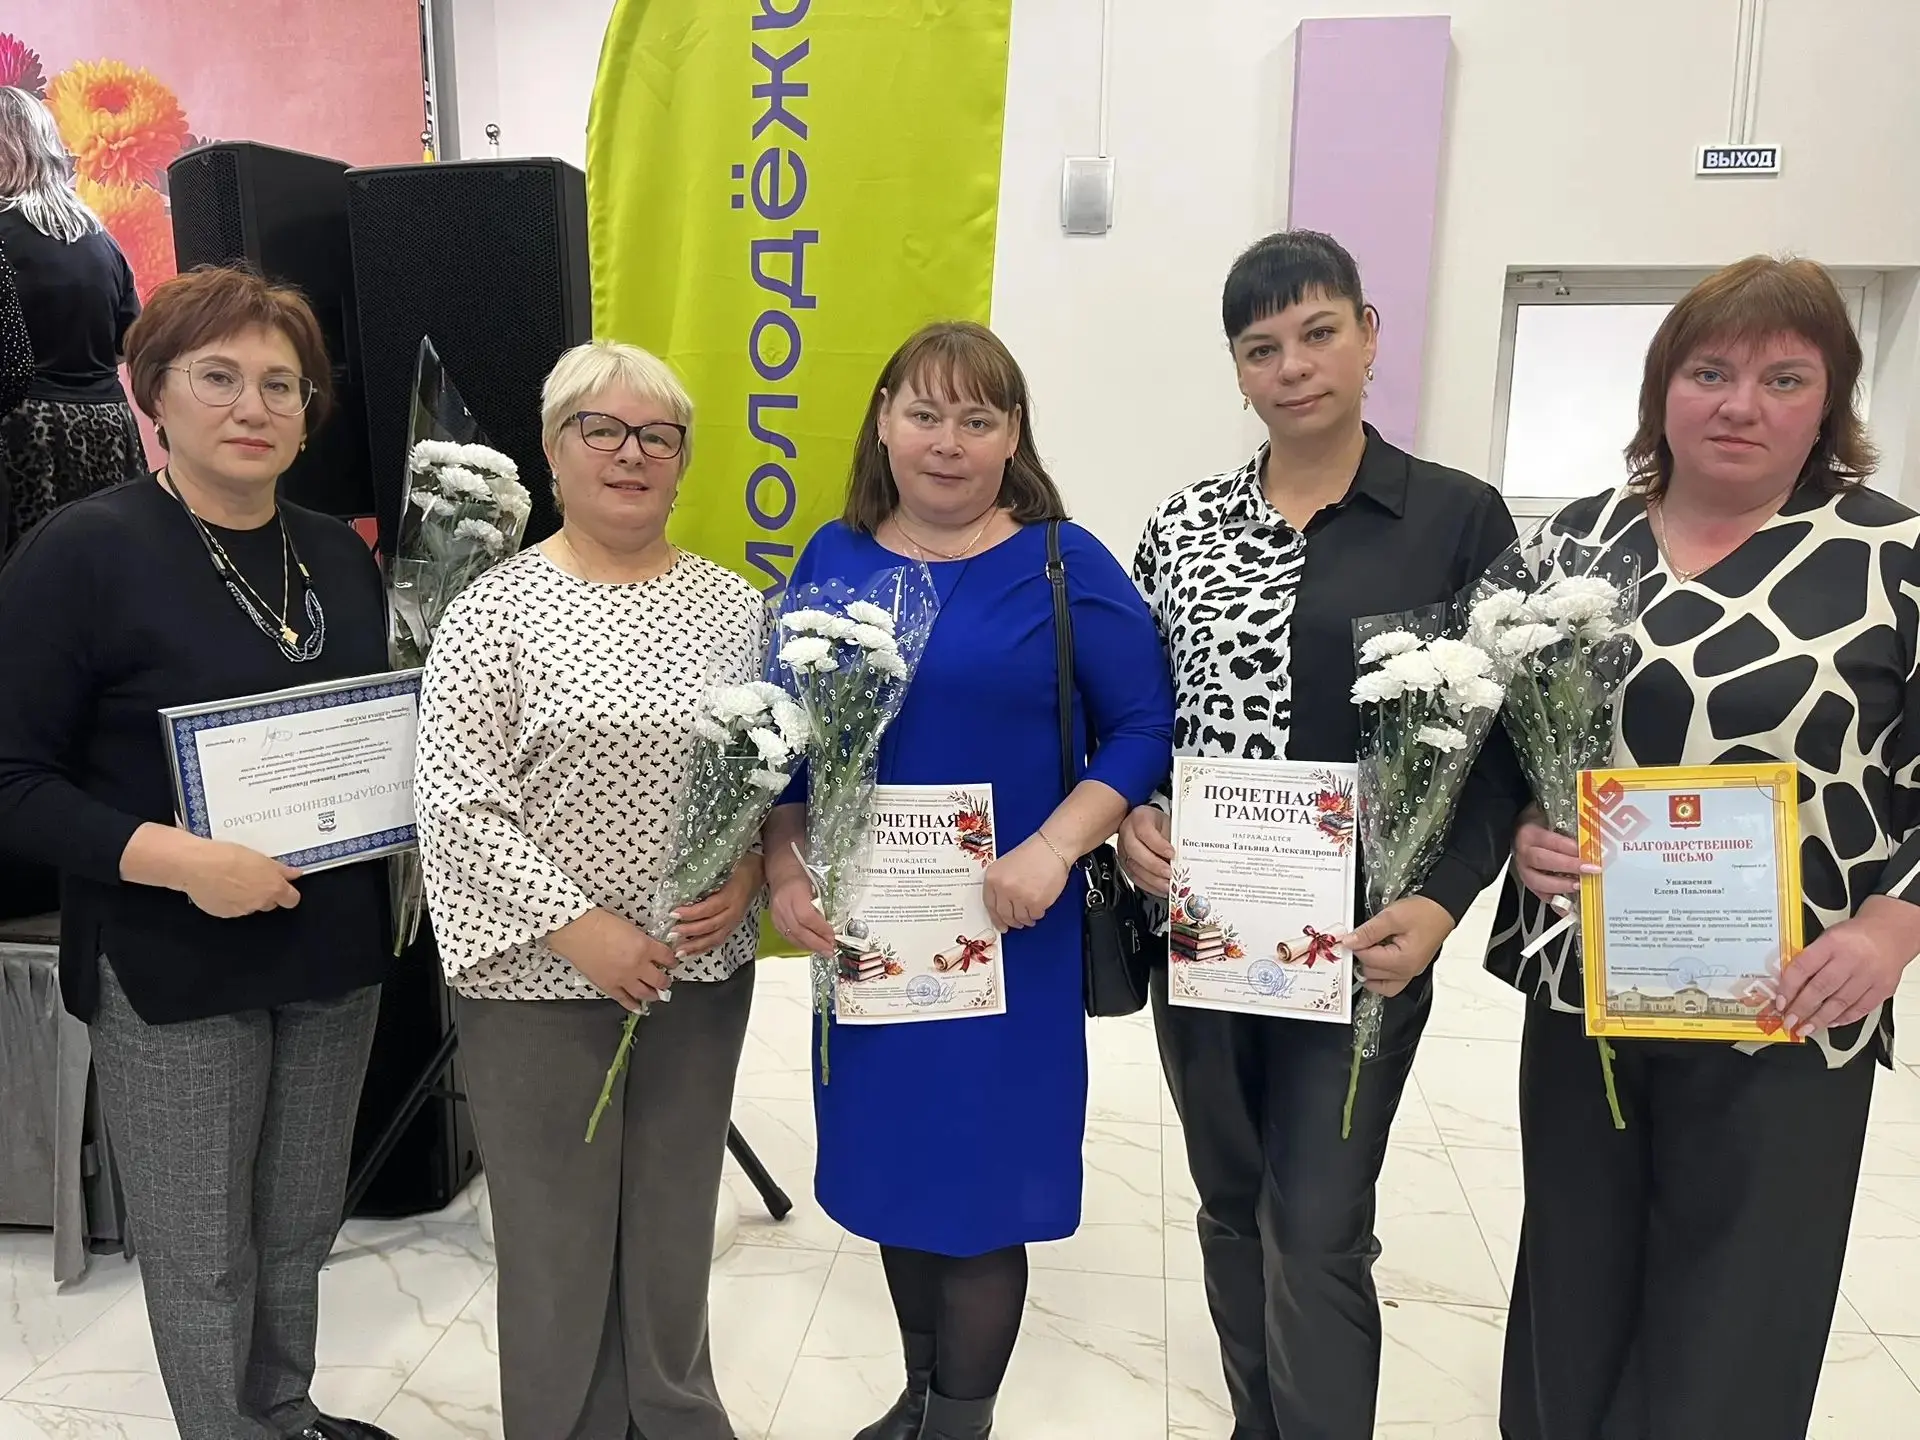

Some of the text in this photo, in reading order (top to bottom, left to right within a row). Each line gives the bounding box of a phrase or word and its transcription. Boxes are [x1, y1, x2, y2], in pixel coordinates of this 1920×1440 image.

[1705, 151, 1773, 167] ВЫХОД
[1203, 785, 1320, 807] ПОЧЕТНАЯ
[224, 808, 282, 829] ПИСЬМО
[870, 813, 959, 828] ОЧЕТНАЯ
[1214, 804, 1312, 825] ГРАМОТА
[1232, 833, 1291, 843] НАГРАЖДАЕТСЯ
[1182, 838, 1343, 858] Кислякова Татьяна Александровна
[1623, 839, 1754, 852] БЛАГОДАРСТВЕННОЕ
[882, 857, 937, 865] НАГРАЖДАЕТСЯ
[1662, 852, 1714, 863] ПИСЬМО
[889, 866, 916, 876] Ольга
[917, 866, 970, 876] Николаевна
[1665, 878, 1712, 886] Уважаемая
[1653, 886, 1725, 895] Елена Павловна!
